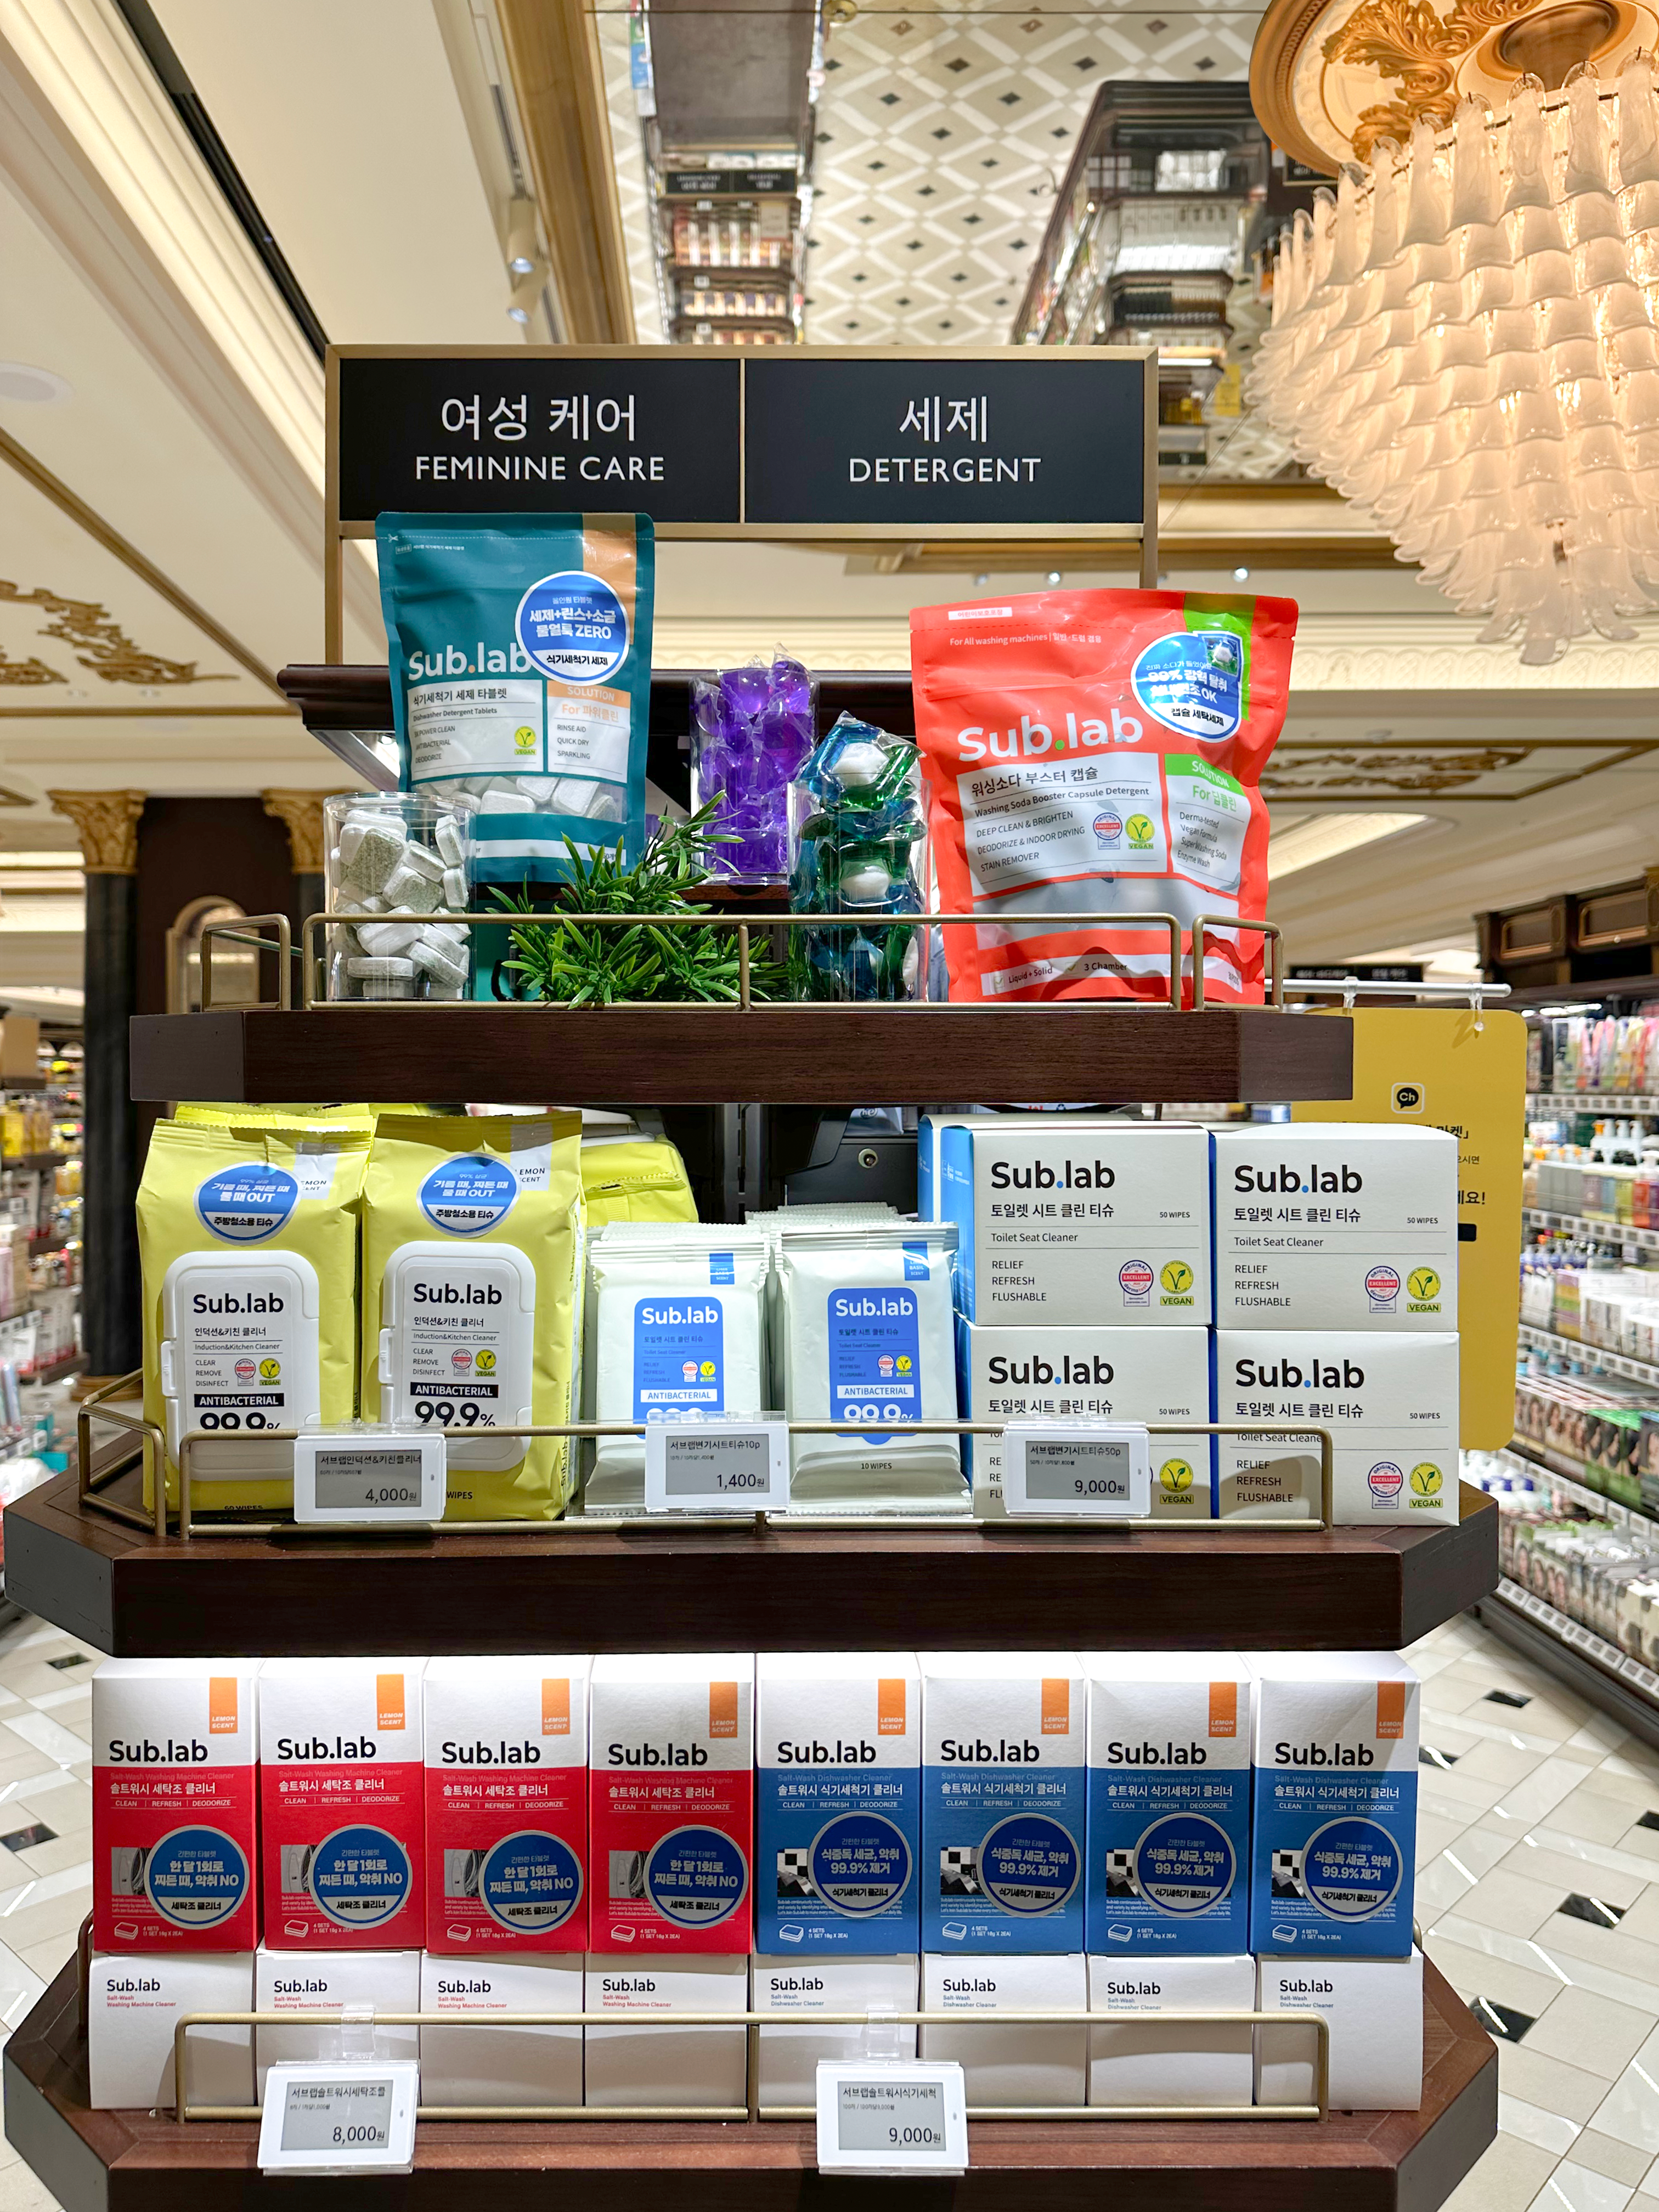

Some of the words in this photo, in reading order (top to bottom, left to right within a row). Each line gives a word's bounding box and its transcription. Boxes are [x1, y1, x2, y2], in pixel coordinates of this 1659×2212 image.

[440, 394, 528, 441] 여성
[548, 394, 637, 441] 케어
[898, 396, 989, 443] 세제
[416, 456, 566, 481] FEMININE
[579, 456, 665, 481] CARE
[849, 458, 1041, 483] DETERGENT
[529, 608, 616, 624] 세제+린스+소금
[536, 623, 573, 637] 물얼룩
[575, 627, 611, 639] ZERO
[975, 636, 1008, 645] washing
[1009, 633, 1047, 643] machines
[408, 642, 532, 681] Sub.lab
[547, 655, 590, 665] 식기세척기
[591, 656, 608, 666] 세제
[413, 691, 453, 706] 식기세척기
[456, 690, 475, 701] 세제
[478, 688, 507, 699] 타블렛
[567, 686, 614, 702] SOLUTION
[1201, 688, 1217, 703] OK
[413, 710, 442, 722] Dishwasher
[443, 708, 473, 716] Detergent
[475, 707, 497, 715] Tablets
[562, 704, 580, 714] For
[582, 705, 618, 723] 파워클린
[1171, 708, 1190, 717] 캡슐
[1193, 709, 1224, 726] 세탁세제
[420, 727, 437, 736] POWER
[957, 708, 1143, 761] Sub.lab
[416, 739, 451, 750] ANTIBACTERIAL
[557, 737, 574, 746] QUICK
[415, 753, 442, 764] DEODORIZE
[557, 749, 590, 759] SPARKLING
[972, 773, 1021, 797] 워싱소다
[1026, 770, 1066, 784] 부스터
[1071, 767, 1098, 781] 캡슐
[1192, 760, 1229, 788] SOLUTION
[975, 802, 1010, 817] Washing
[1011, 798, 1031, 809] Soda
[1032, 792, 1066, 803] Booster
[1068, 789, 1103, 799] Capsule
[1106, 787, 1149, 797] Detergent
[1193, 785, 1210, 799] For
[1212, 791, 1237, 812] 딥클린
[977, 827, 997, 838] DEEP
[998, 822, 1024, 833] CLEAN
[1032, 811, 1073, 827] BRIGHTEN
[1180, 812, 1220, 828] Derma-tested
[978, 839, 1017, 855] DEODORIZE
[1026, 833, 1056, 844] INDOOR
[1058, 827, 1085, 839] DRYING
[1181, 824, 1199, 836] Vegan
[1200, 830, 1218, 843] Formula
[981, 860, 1001, 872] STAIN
[1002, 853, 1039, 867] REMOVER
[1177, 850, 1196, 862] Enzyme
[1197, 857, 1210, 867] Wash
[1092, 962, 1127, 971] Chamber
[1008, 973, 1028, 984] Liquid
[1034, 967, 1053, 977] Solid
[1400, 1092, 1415, 1102] Ch
[991, 1160, 1115, 1189] Sub.lab
[1234, 1164, 1362, 1193] Sub.lab
[247, 1193, 275, 1203] OUT
[991, 1204, 1028, 1218] 토일렛
[1032, 1204, 1057, 1218] 시트
[1060, 1204, 1085, 1217] 클린
[1090, 1204, 1114, 1218] 티슈
[214, 1217, 255, 1226] 주방청소용
[257, 1218, 273, 1226] 티슈
[991, 1233, 1017, 1242] Toilet
[1019, 1233, 1040, 1242] Seat
[1042, 1233, 1078, 1242] Cleaner
[992, 1261, 1024, 1269] RELIEF
[992, 1277, 1035, 1285] REFRESH
[414, 1283, 502, 1305] Sub.lab
[992, 1293, 1047, 1301] FLUSHABLE
[193, 1293, 284, 1313] Sub.lab
[836, 1297, 913, 1316] Sub.lab
[642, 1306, 718, 1324] Sub.lab
[195, 1327, 240, 1336] 인덕션&키친
[242, 1327, 266, 1336] 클리너
[195, 1343, 253, 1351] Induction&Kitchen
[988, 1356, 1114, 1384] Sub.lab
[1235, 1359, 1364, 1389] Sub.lab
[415, 1385, 493, 1396] ANTIBACTERIAL
[647, 1391, 710, 1400] ANTIBACTERIAL
[844, 1387, 908, 1395] ANTIBACTERIAL
[199, 1395, 279, 1406] ANTIBACTERIAL
[415, 1401, 495, 1426] 99.9%
[670, 1440, 760, 1451] 서브랩변기시트티슈10p
[1030, 1446, 1121, 1457] 서브랩변기시트티슈50p
[320, 1454, 422, 1466] 서브랩인덕션&키친클리너
[717, 1474, 764, 1490] 1,400원
[1074, 1480, 1125, 1496] 9,000원
[365, 1488, 417, 1504] 4,000원
[447, 1491, 472, 1500] WIPES
[109, 1739, 208, 1762] Sub.lab
[277, 1736, 376, 1760] Sub.lab
[442, 1740, 540, 1764] Sub.lab
[608, 1742, 708, 1767] Sub.lab
[777, 1740, 876, 1763] Sub.lab
[940, 1739, 1040, 1762] Sub.lab
[1107, 1742, 1206, 1765] Sub.lab
[1274, 1742, 1374, 1767] Sub.lab
[110, 1782, 149, 1795] 솔트워시
[152, 1782, 183, 1795] 세탁조
[185, 1782, 216, 1795] 클리너
[777, 1784, 818, 1796] 솔트워시
[821, 1784, 870, 1796] 식기세척기
[873, 1784, 902, 1796] 클리너
[822, 1848, 852, 1861] 식중독
[854, 1849, 877, 1862] 세균,
[879, 1848, 899, 1860] 악취
[170, 1860, 181, 1873] 한
[183, 1860, 195, 1873] 달
[196, 1860, 224, 1873] 1회로
[831, 1862, 867, 1874] 99.9%
[869, 1862, 890, 1874] 제거
[155, 1874, 177, 1887] 찌든
[179, 1874, 194, 1888] 때,
[195, 1874, 217, 1886] 악취
[219, 1874, 239, 1886] NO
[171, 1901, 195, 1911] 세탁조
[198, 1901, 221, 1911] 클리너
[107, 1978, 160, 1993] Sub.lab
[1279, 1979, 1333, 1993] Sub.lab
[291, 2086, 385, 2098] 서브랩솔트워시세탁조클
[843, 2087, 936, 2098] 서브랩솔트워시식기세척
[333, 2126, 385, 2145] 8,000원
[889, 2127, 941, 2146] 9,000원
